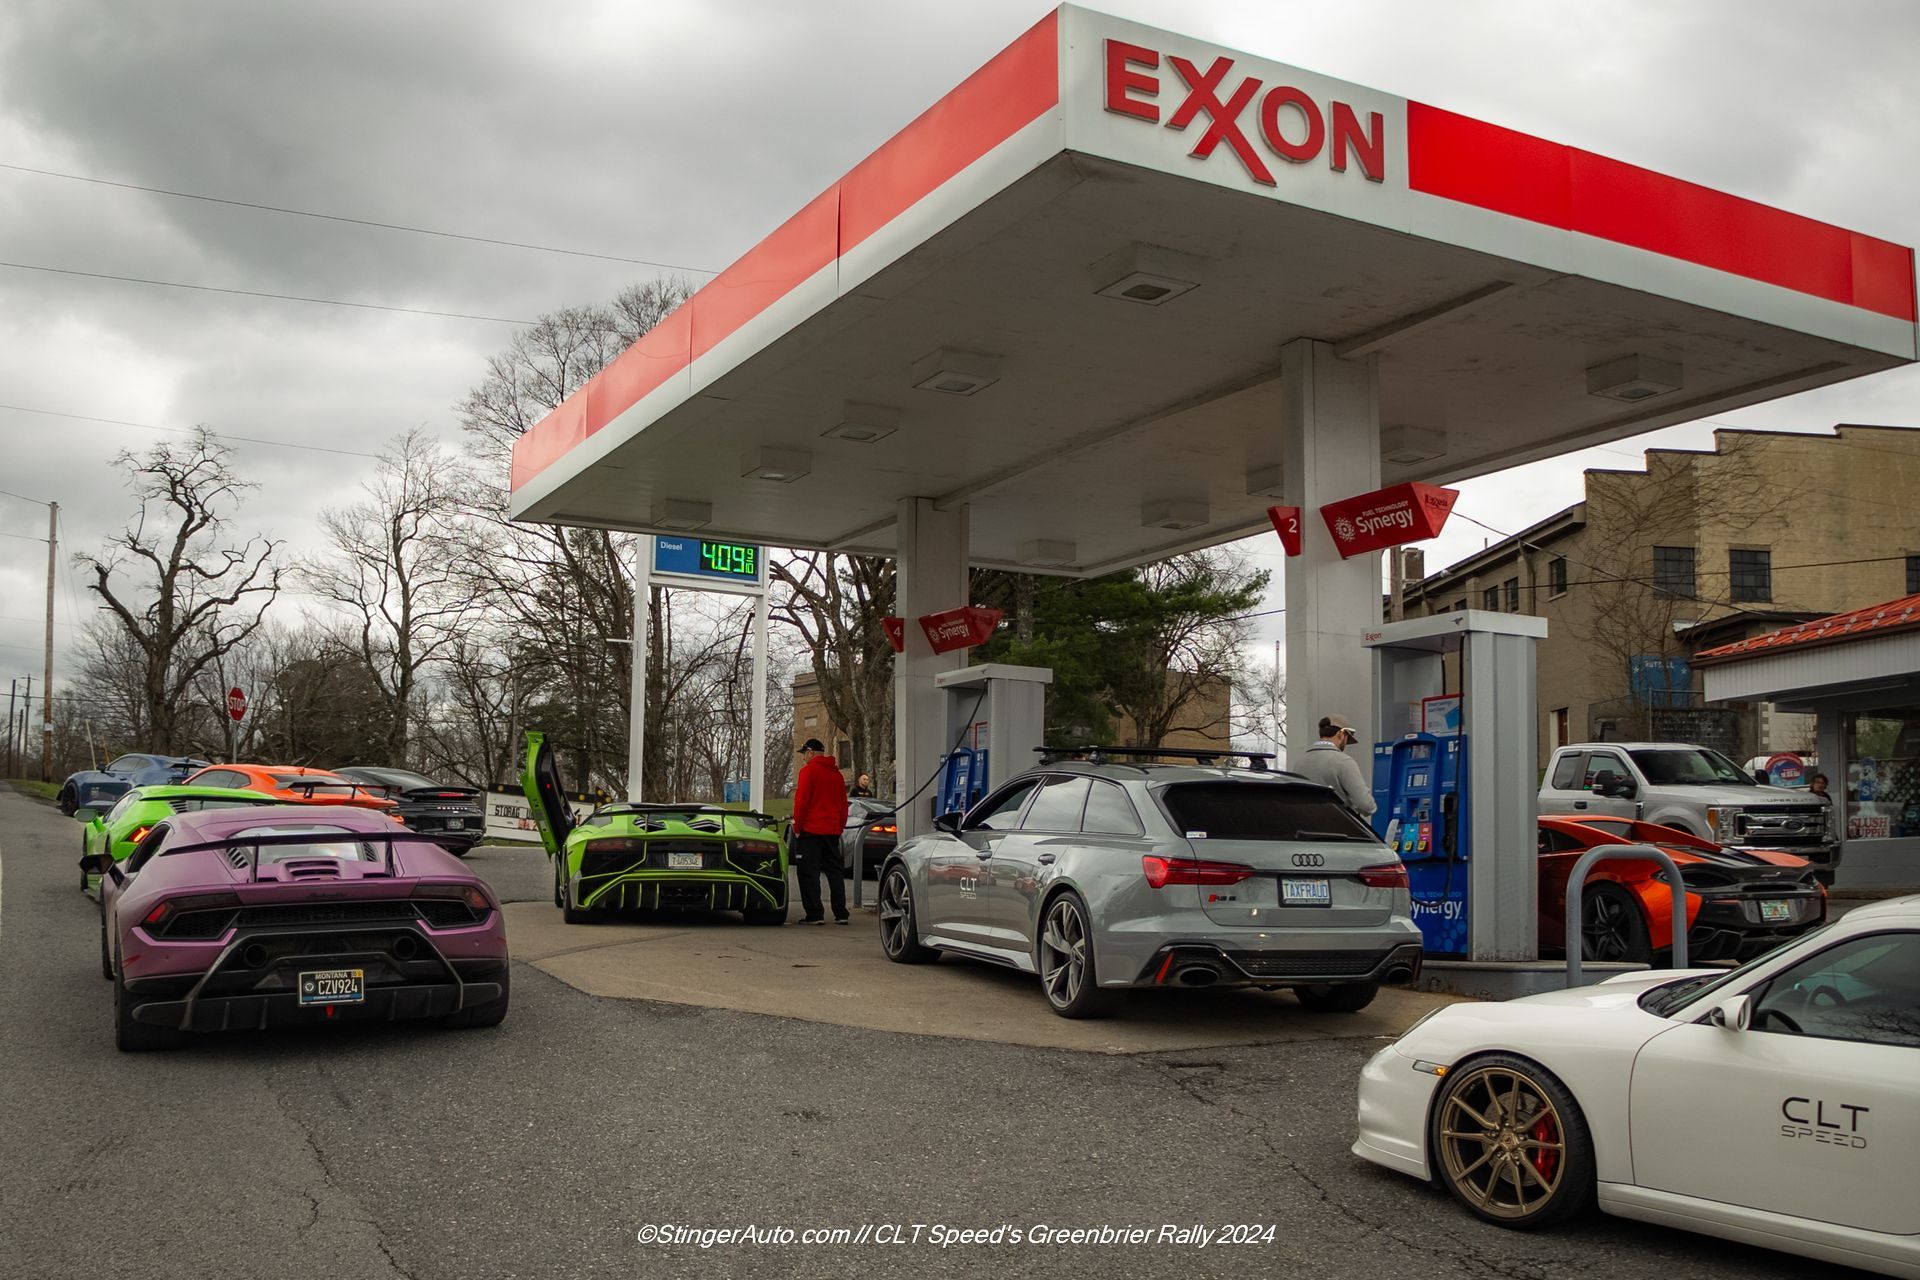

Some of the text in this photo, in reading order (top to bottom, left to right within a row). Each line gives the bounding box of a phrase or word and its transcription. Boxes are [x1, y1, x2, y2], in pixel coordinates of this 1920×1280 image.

[1103, 38, 1384, 187] EXXON
[1288, 518, 1297, 533] 2
[1355, 508, 1414, 536] Synergy
[660, 541, 683, 551] Diesel
[893, 626, 901, 637] 4
[938, 624, 970, 640] Synergy
[230, 697, 246, 711] STOP
[1850, 817, 1888, 827] SLUSH
[960, 876, 978, 892] CLT
[1283, 883, 1328, 898] TAXFRAUD
[1410, 901, 1463, 920] ynergy
[315, 971, 348, 980] MONTANA
[318, 979, 358, 995] CZV924
[1782, 1097, 1869, 1132] CLT
[1781, 1125, 1867, 1149] SPEED
